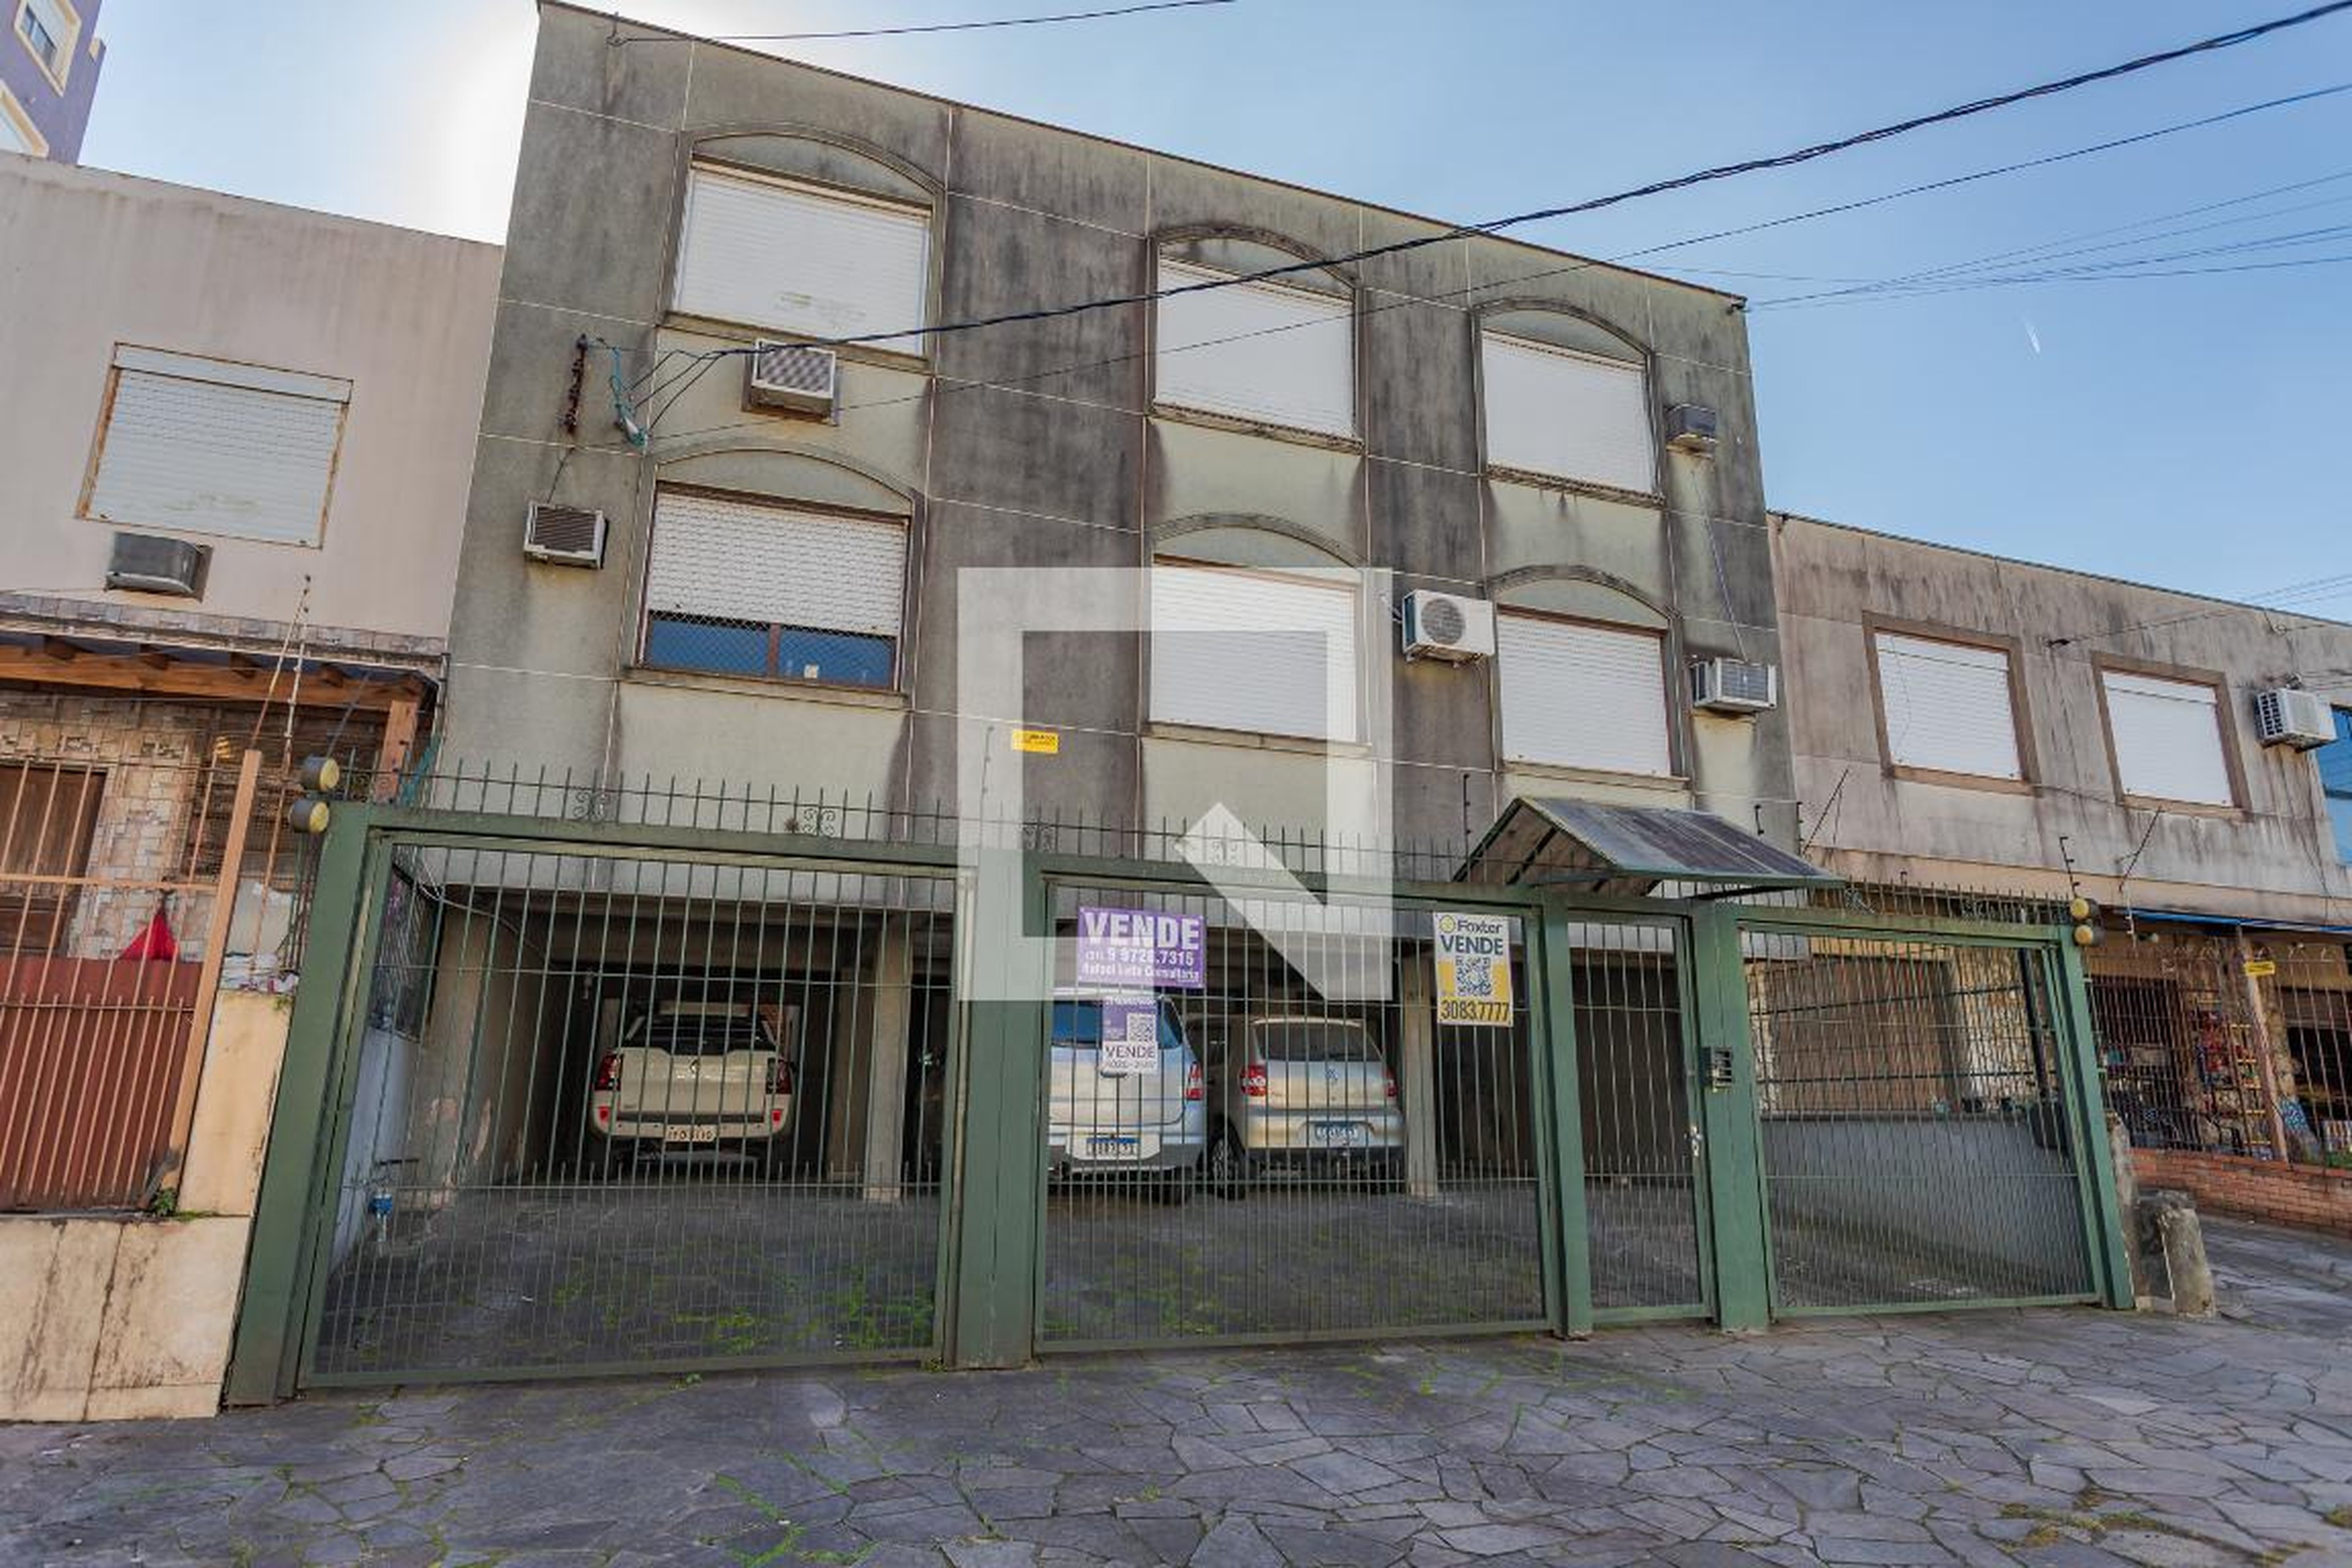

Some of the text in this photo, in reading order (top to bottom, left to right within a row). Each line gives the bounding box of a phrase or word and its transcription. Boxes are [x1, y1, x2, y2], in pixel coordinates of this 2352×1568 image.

[1084, 912, 1199, 949] VENDE
[1457, 920, 1502, 934] Foxter
[1441, 935, 1503, 956] VENDE
[1105, 1046, 1156, 1058] VENDE
